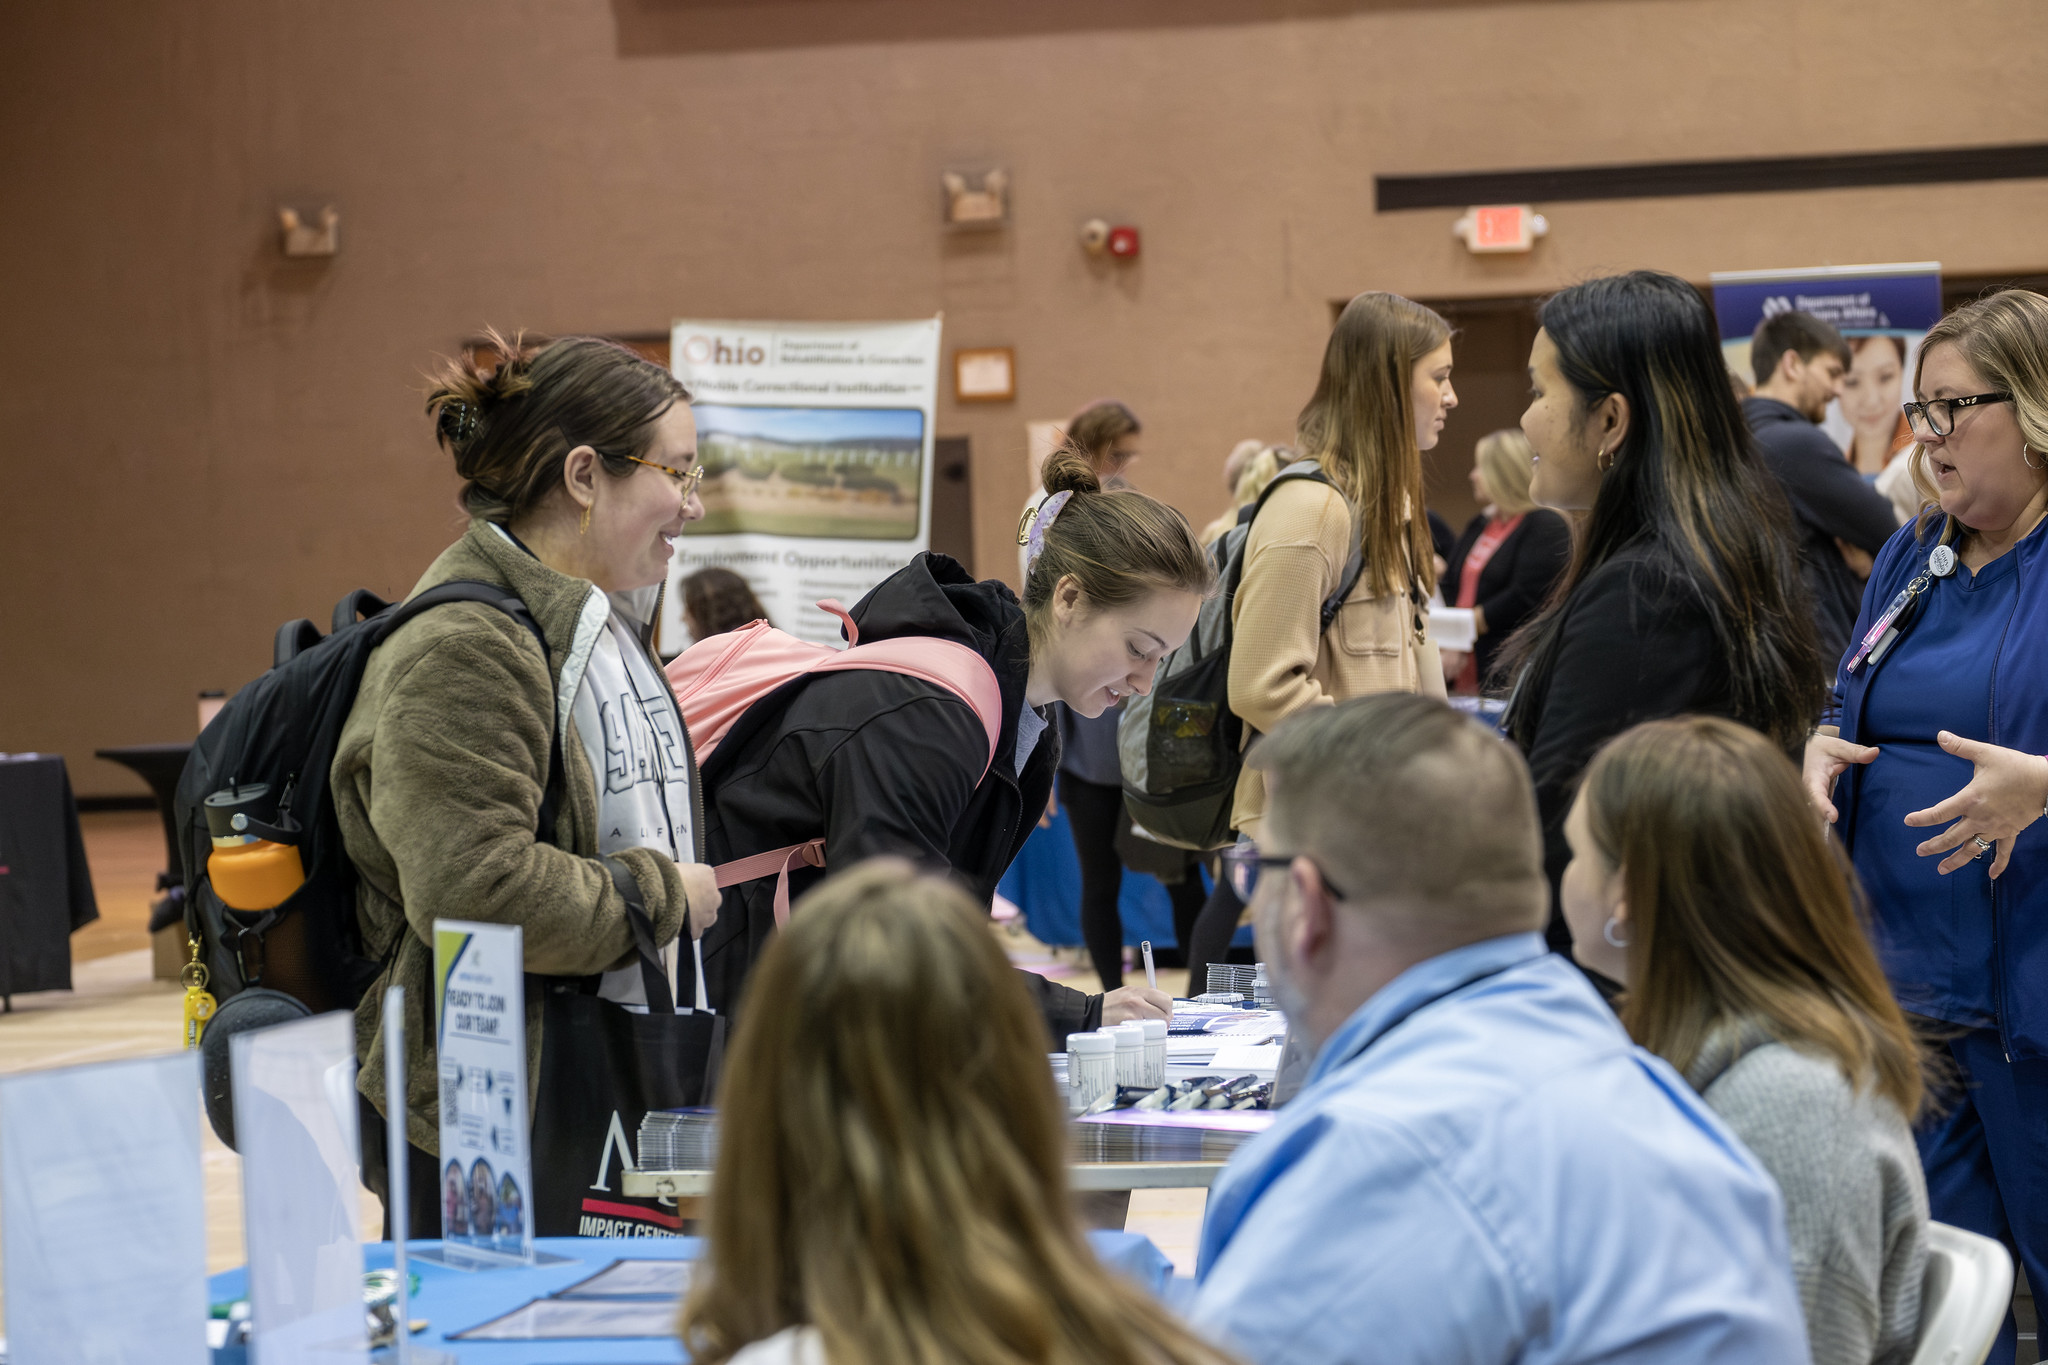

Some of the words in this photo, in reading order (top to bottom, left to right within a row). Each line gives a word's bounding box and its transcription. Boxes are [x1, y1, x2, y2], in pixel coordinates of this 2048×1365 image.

[683, 335, 765, 366] Ohio
[679, 550, 778, 569] Employment
[579, 1214, 634, 1239] IMPACT
